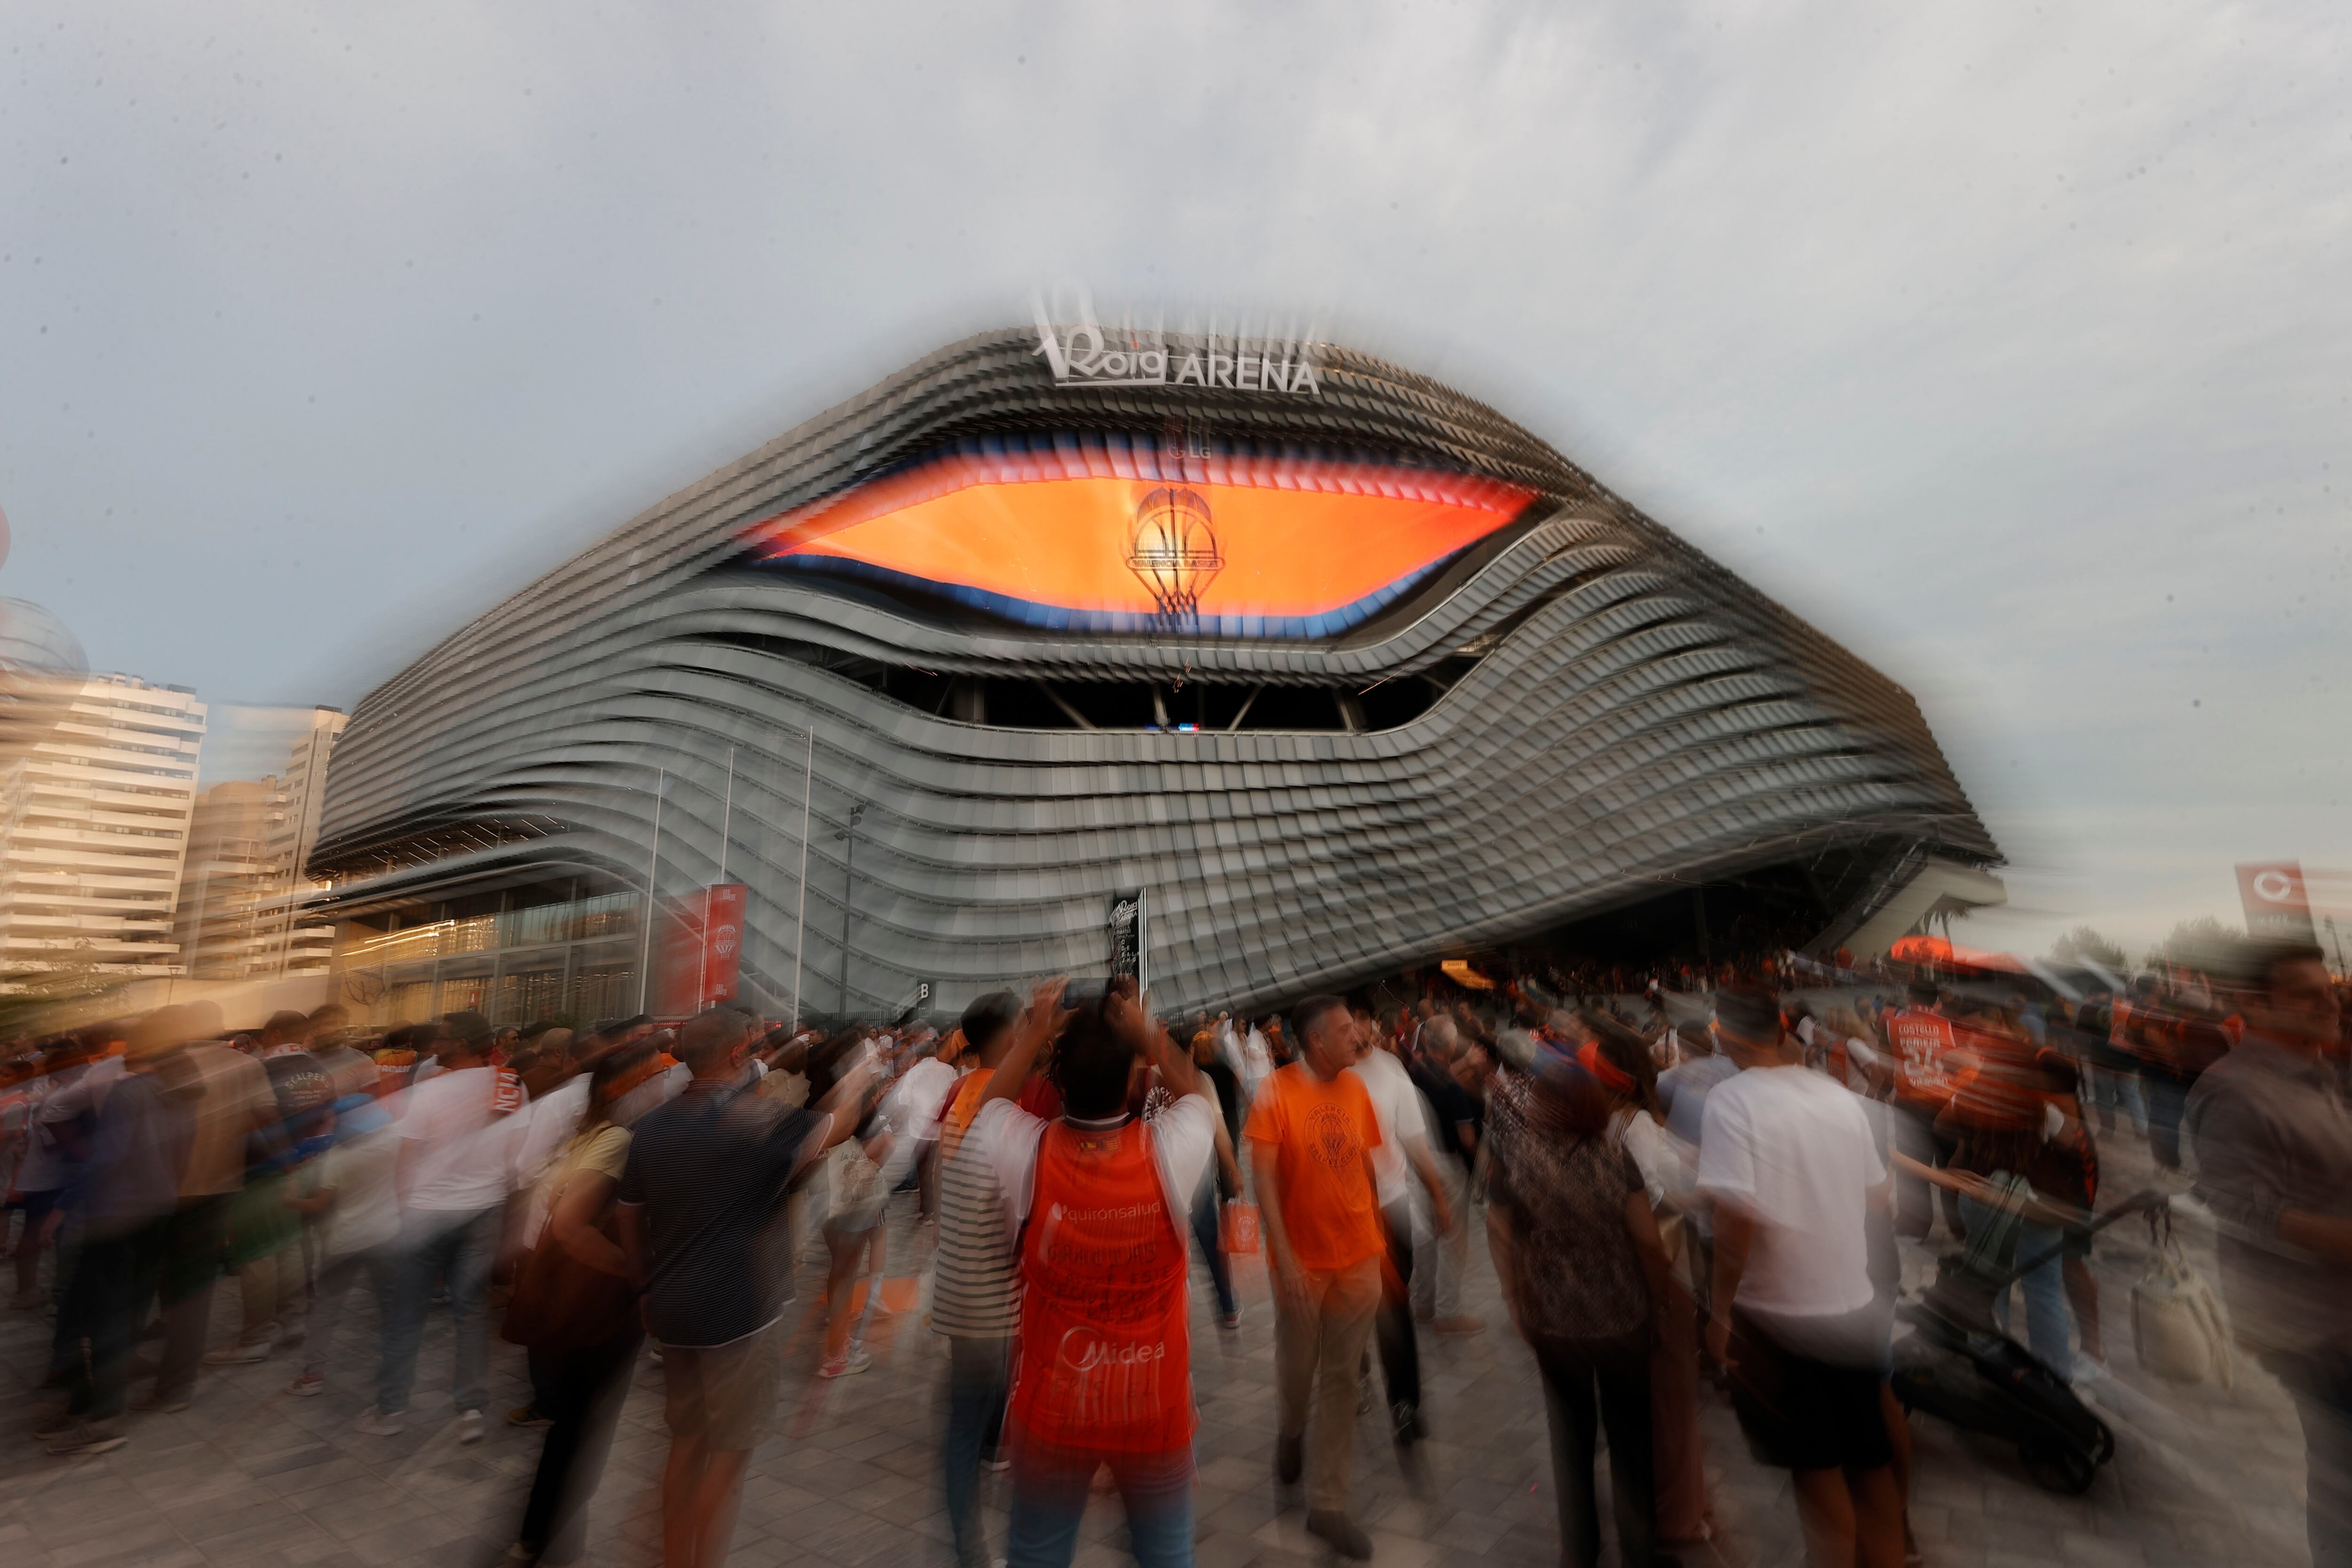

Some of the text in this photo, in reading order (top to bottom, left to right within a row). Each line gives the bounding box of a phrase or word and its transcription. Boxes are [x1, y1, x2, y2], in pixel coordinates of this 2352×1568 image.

[1033, 325, 1320, 394] Roig ARENA
[1190, 446, 1212, 459] LG
[921, 983, 929, 998] B
